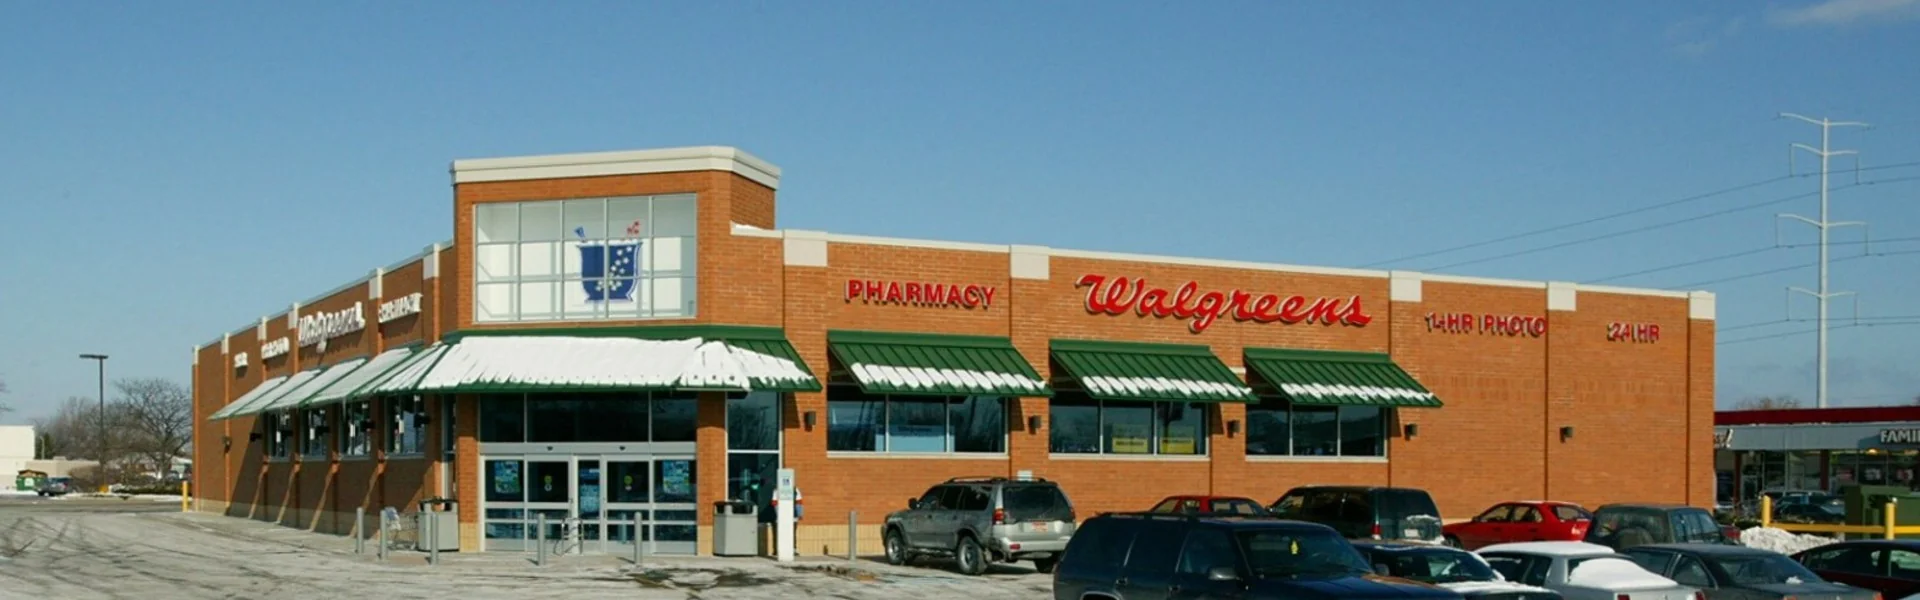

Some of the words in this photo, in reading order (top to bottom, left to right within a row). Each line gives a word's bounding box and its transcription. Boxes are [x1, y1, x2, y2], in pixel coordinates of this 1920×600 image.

[845, 279, 995, 309] PHARMACY
[1076, 274, 1372, 333] Walgreens
[1479, 314, 1547, 337] PHOTO
[1880, 429, 1920, 443] FAMI
